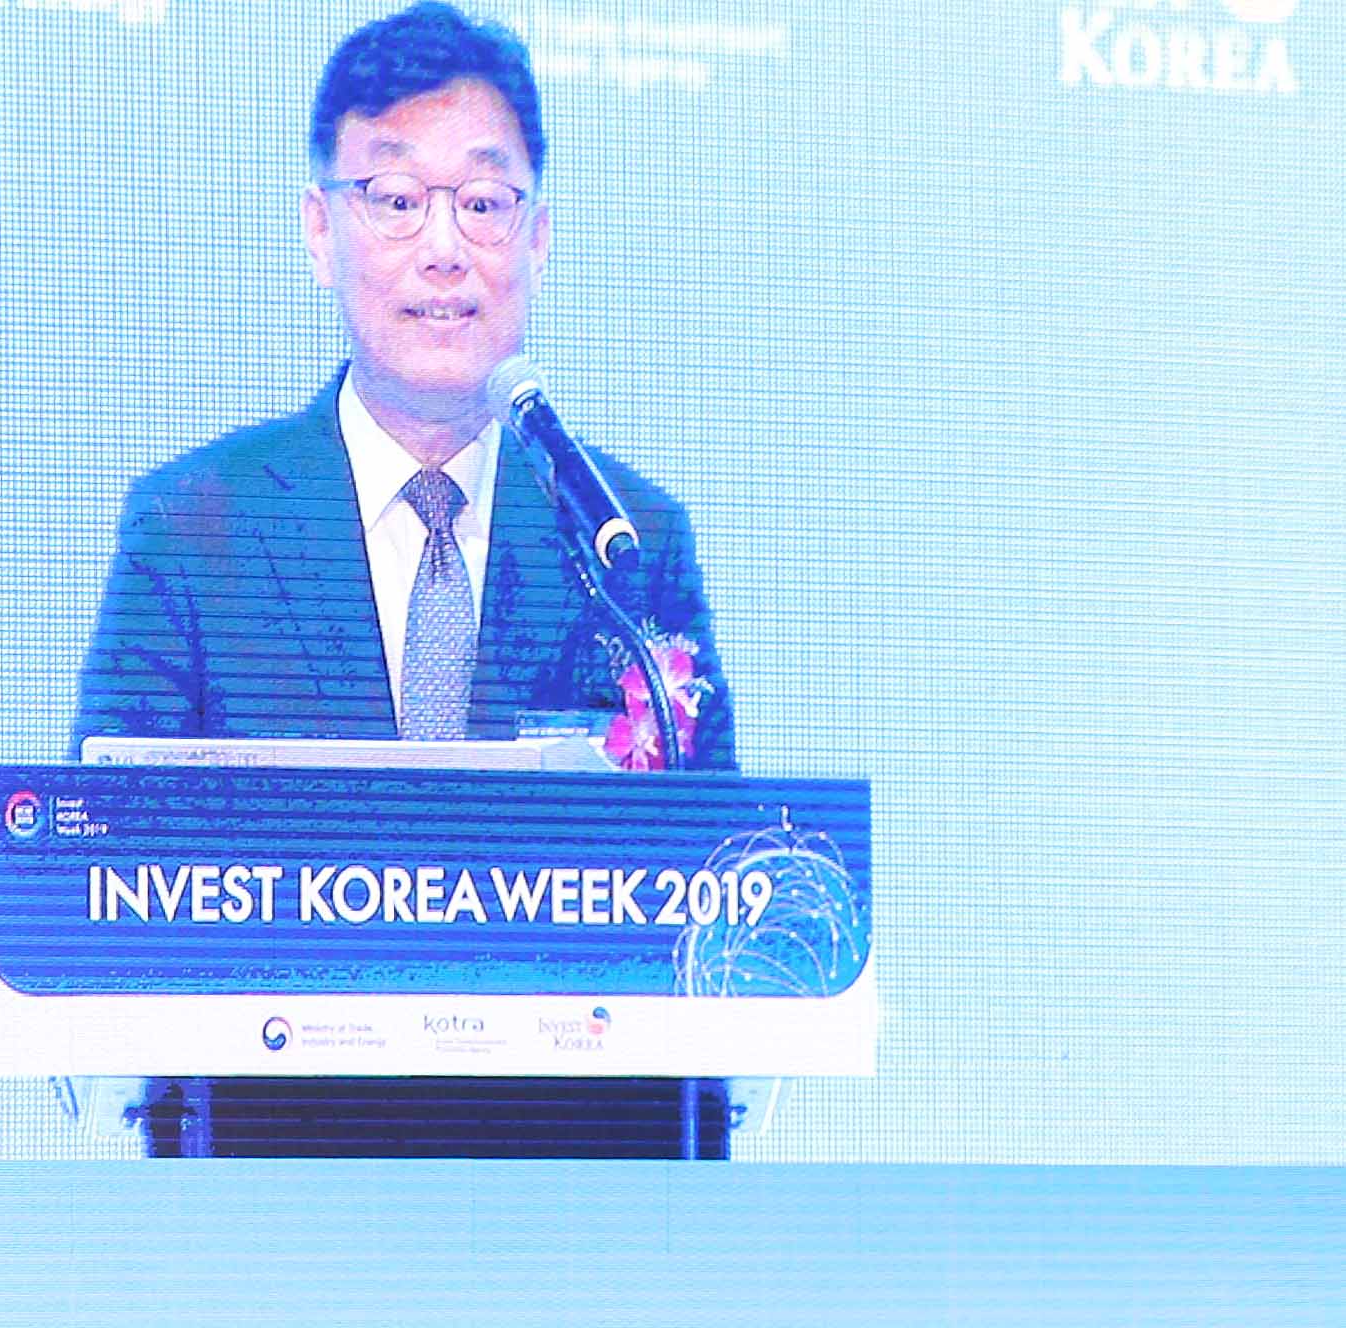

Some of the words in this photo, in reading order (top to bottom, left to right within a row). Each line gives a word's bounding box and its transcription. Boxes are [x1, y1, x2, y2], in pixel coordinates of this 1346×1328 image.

[1061, 5, 1296, 93] KOREA
[88, 864, 283, 923] INVEST
[299, 864, 489, 925] KOREA
[489, 866, 648, 926] WEEK
[654, 868, 774, 927] 2019
[423, 1015, 485, 1034] kotra
